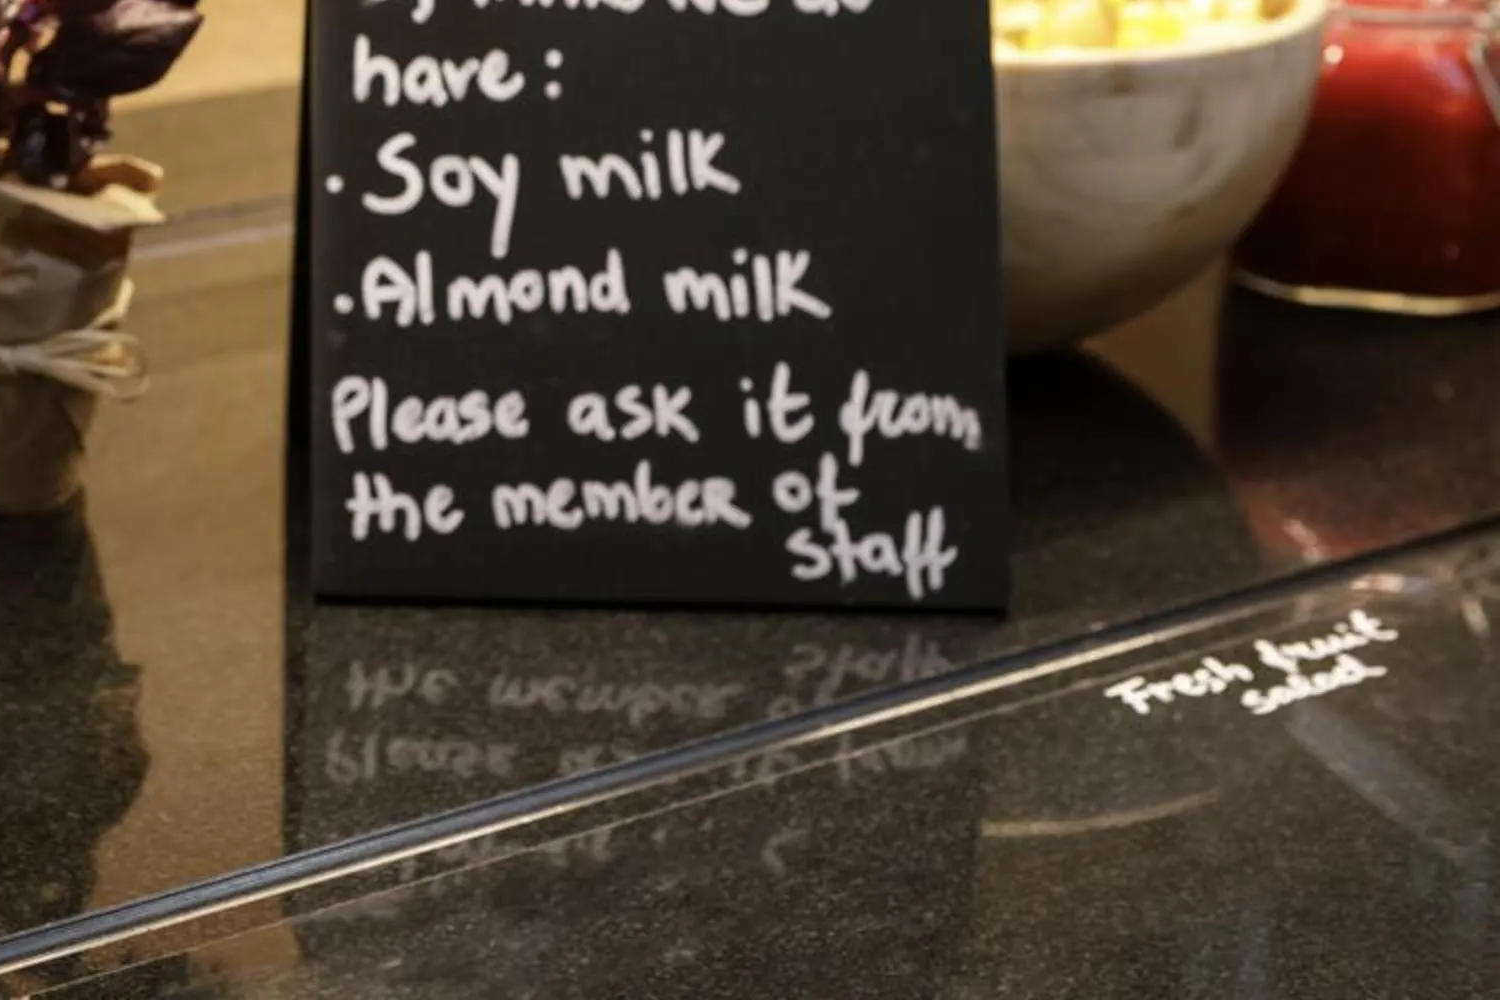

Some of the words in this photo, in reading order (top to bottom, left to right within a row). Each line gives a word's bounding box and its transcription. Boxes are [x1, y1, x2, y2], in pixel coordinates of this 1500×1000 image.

[362, 132, 520, 258] Soy
[559, 129, 741, 200] milk
[663, 248, 832, 322] milk
[332, 375, 529, 453] Please
[567, 384, 699, 442] ask
[740, 362, 814, 443] it
[839, 370, 983, 466] from
[346, 472, 464, 541] the
[773, 451, 860, 533] of
[786, 508, 957, 600] staff
[1104, 656, 1255, 715] Fresh
